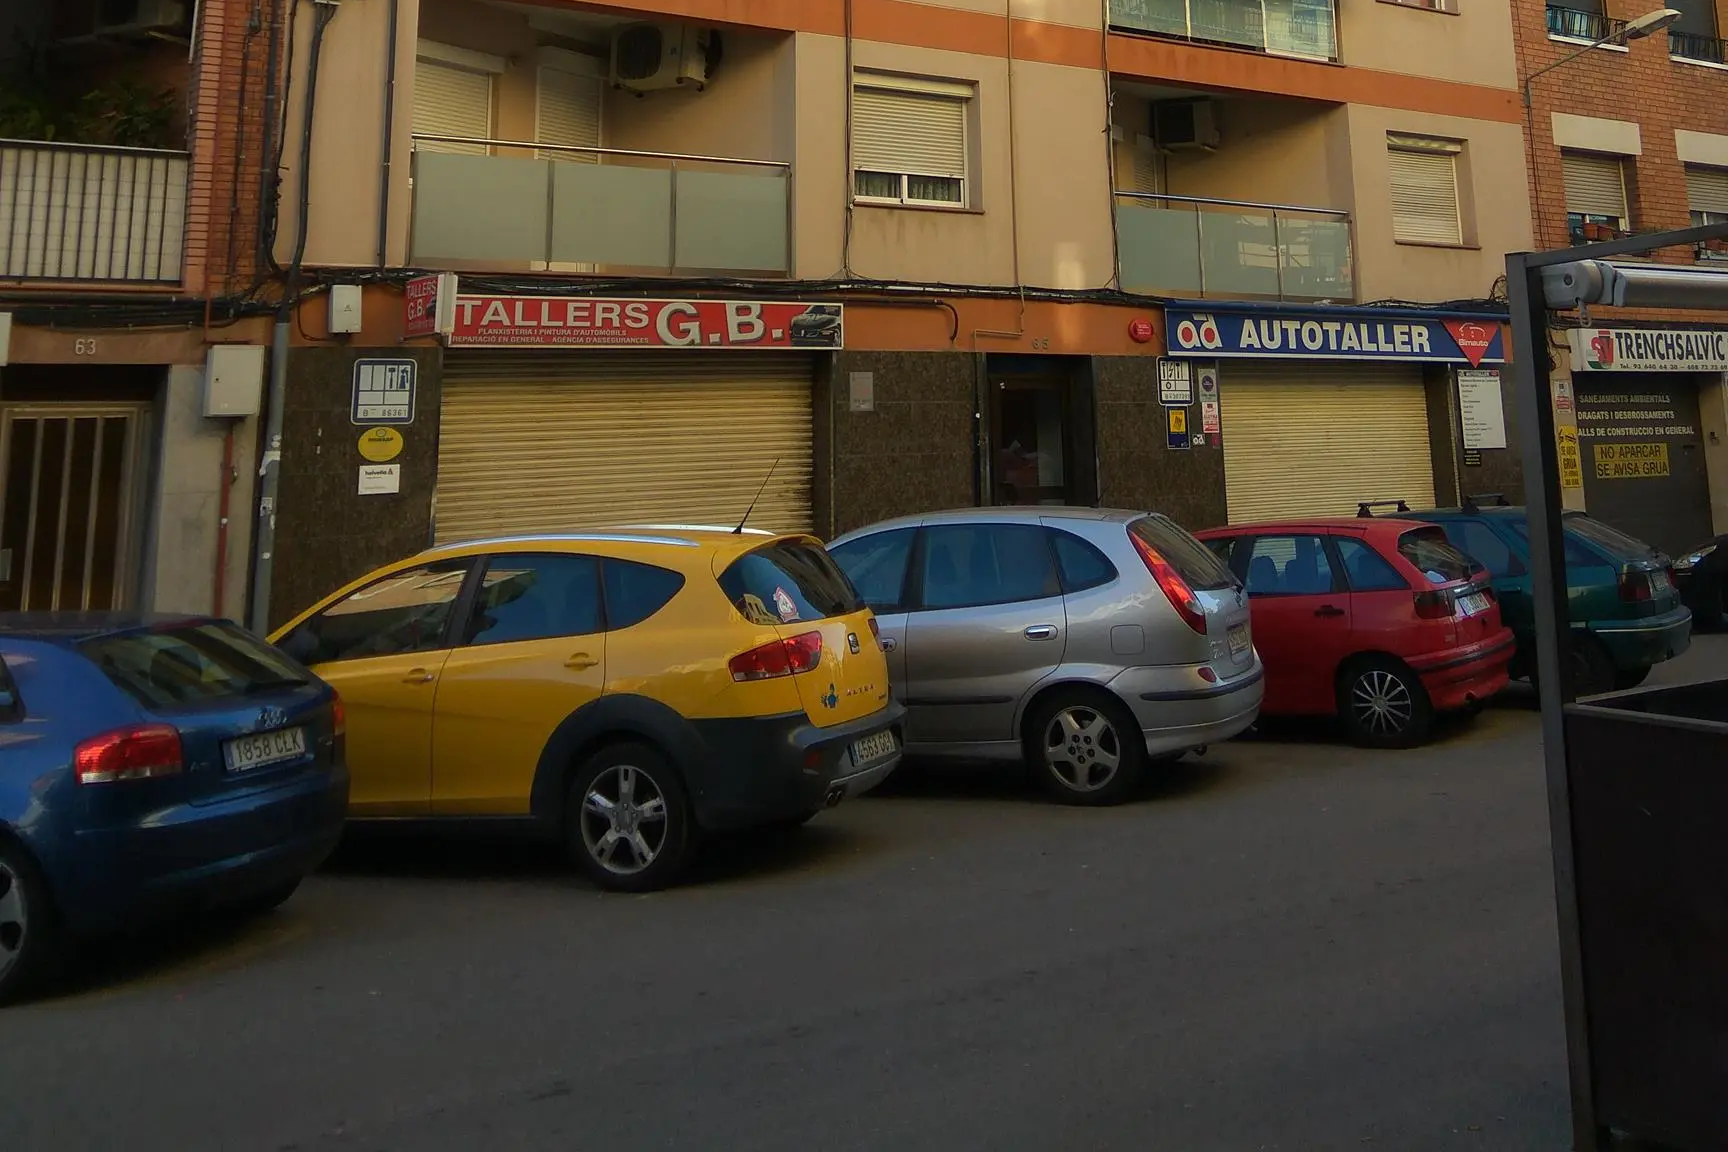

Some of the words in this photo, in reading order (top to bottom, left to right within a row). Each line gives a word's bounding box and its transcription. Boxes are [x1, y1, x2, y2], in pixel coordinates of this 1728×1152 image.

[407, 280, 437, 299] TALLERS
[456, 300, 649, 328] TALLERS
[656, 301, 784, 346] G.B.
[478, 328, 532, 336] PLANXISTERIA
[539, 328, 572, 336] PINTURA
[1240, 319, 1432, 353] AUTOTALLER
[75, 339, 96, 355] 63
[1458, 338, 1489, 347] Bimauto
[1579, 395, 1629, 404] SANEJAMENTS
[1630, 394, 1671, 403] AMBIENTALS
[1578, 411, 1609, 420] DRAGATS
[1615, 411, 1675, 420] DESBROSSAMENTS
[1596, 428, 1606, 436] DE
[1655, 427, 1664, 435] EN
[1665, 426, 1695, 435] GENERAL
[1600, 446, 1615, 459] NO
[1618, 445, 1661, 458] APARCAR
[1597, 463, 1610, 476] SE
[1613, 462, 1640, 475] AVISA
[1643, 461, 1668, 474] GRUA
[236, 737, 272, 763] 1858
[274, 731, 301, 754] CLK
